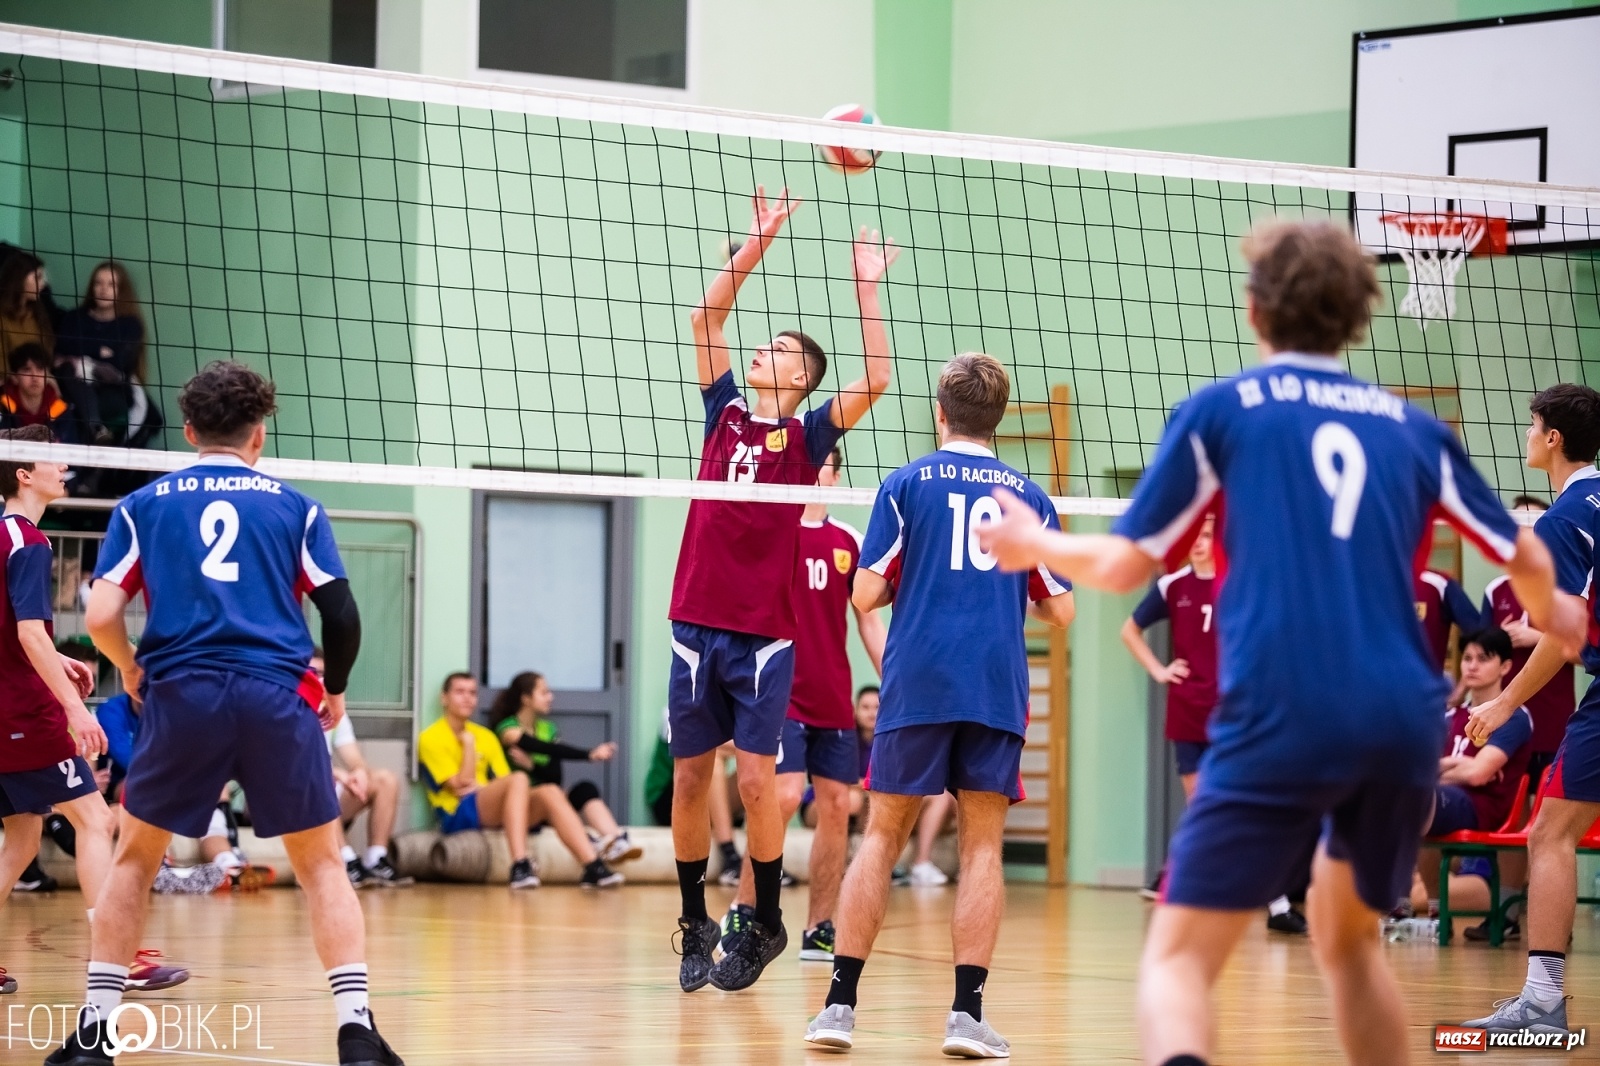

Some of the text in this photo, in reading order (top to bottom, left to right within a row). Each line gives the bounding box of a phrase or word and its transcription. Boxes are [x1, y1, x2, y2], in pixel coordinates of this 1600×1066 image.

[155, 475, 282, 496] II LO RACIBÓRZ
[919, 463, 1025, 493] II LO RACIBÓRZ
[1311, 420, 1367, 541] 9
[199, 499, 240, 582] 2
[948, 492, 1003, 572] 10
[805, 557, 828, 591] 10
[1200, 603, 1213, 633] 7
[57, 757, 84, 789] 2
